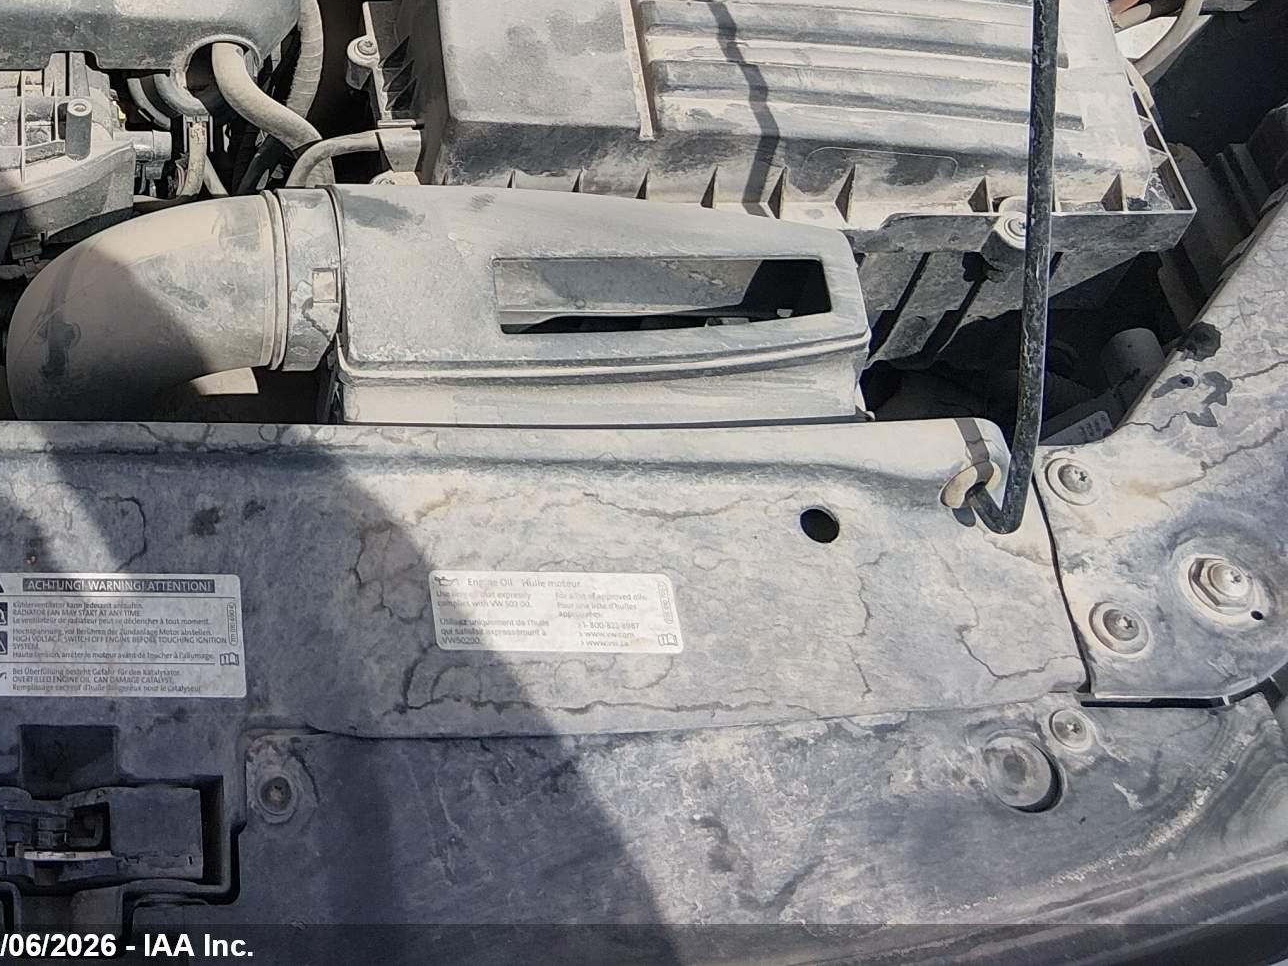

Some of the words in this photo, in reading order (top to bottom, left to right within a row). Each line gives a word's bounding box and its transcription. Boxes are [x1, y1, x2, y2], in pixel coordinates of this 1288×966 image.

[27, 579, 86, 591] ACHTUNG!
[88, 580, 145, 592] WARNING!
[146, 580, 212, 592] ATTENTION!
